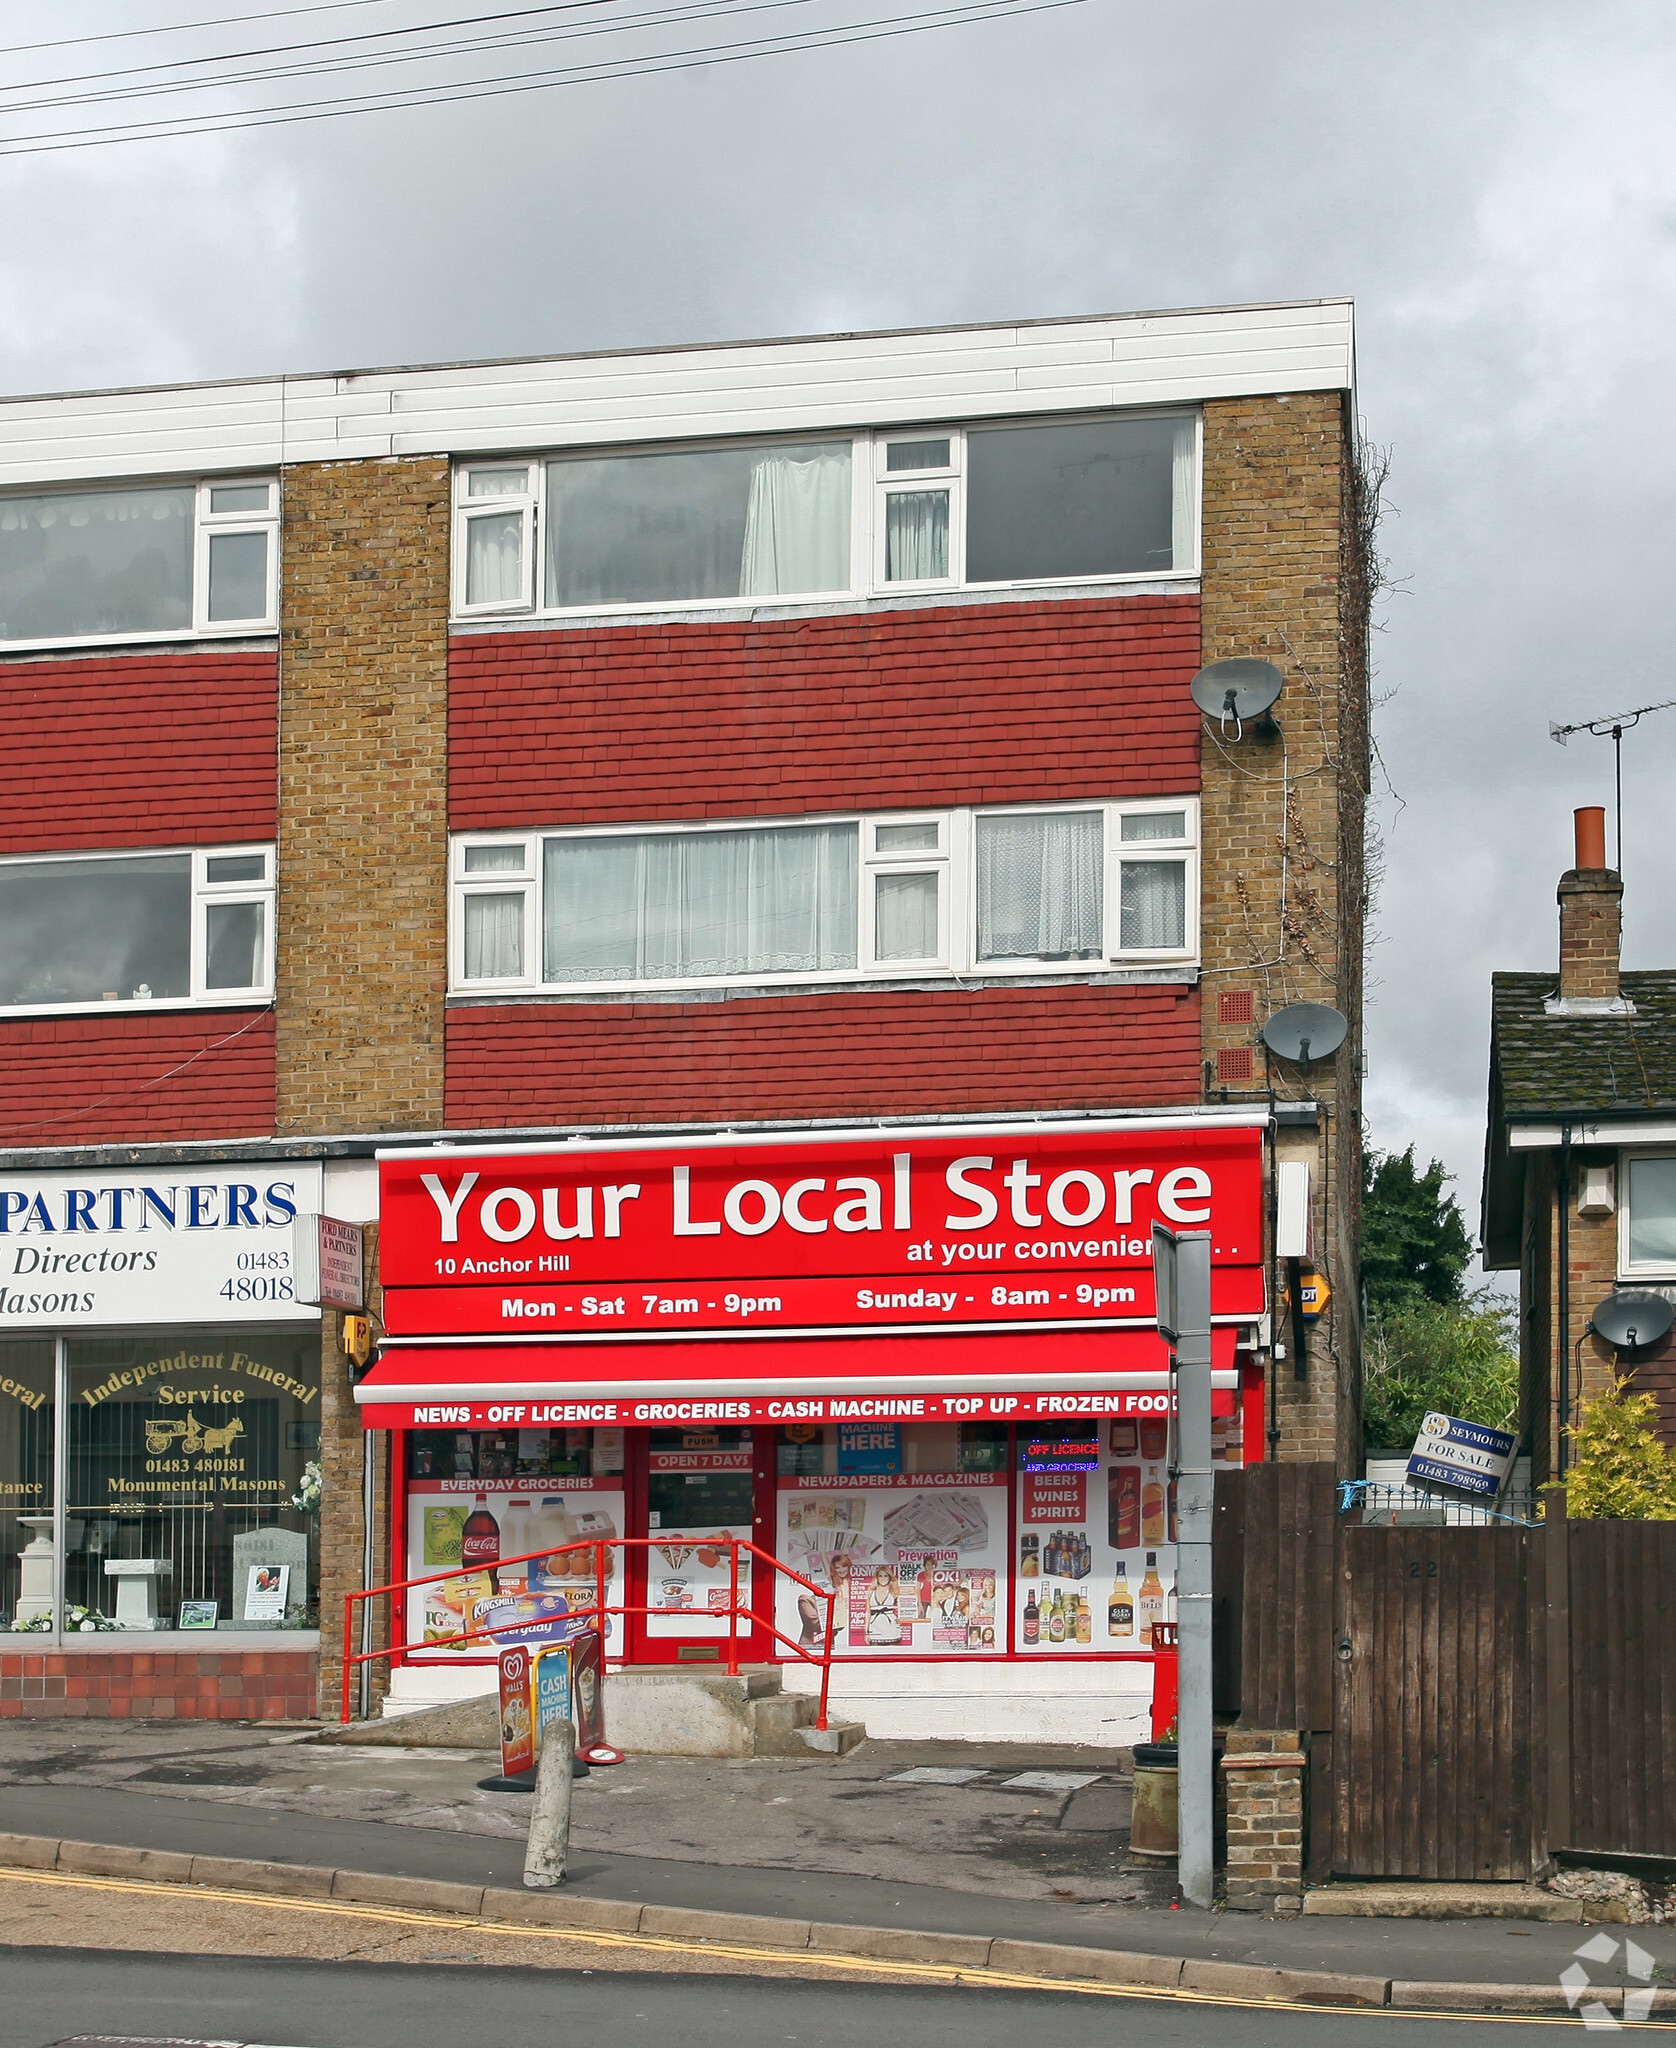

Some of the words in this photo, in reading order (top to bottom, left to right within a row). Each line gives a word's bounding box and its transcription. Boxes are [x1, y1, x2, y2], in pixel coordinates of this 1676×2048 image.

[420, 1171, 641, 1243] Your
[672, 1152, 911, 1237] Local
[945, 1155, 1212, 1231] Store
[0, 1182, 296, 1236] PARTNERS
[321, 1221, 337, 1236] FORD
[329, 1238, 357, 1256] PARTNERS
[906, 1240, 934, 1262] at
[941, 1242, 1005, 1266] your
[12, 1246, 158, 1275] Directors
[237, 1251, 290, 1271] 01483
[434, 1258, 456, 1275] 10
[461, 1256, 533, 1274] Anchor
[538, 1255, 570, 1272] Hill
[219, 1276, 294, 1301] 48018
[1301, 1289, 1317, 1300] DT
[501, 1298, 556, 1317] Mon
[581, 1296, 625, 1316] Sat
[642, 1295, 698, 1314] 7am
[724, 1293, 782, 1317] 9pm
[856, 1287, 957, 1311] Sunday
[990, 1286, 1050, 1306] 8am
[1076, 1284, 1135, 1307] 9pm
[80, 1351, 224, 1408] Independent
[230, 1352, 319, 1405] Funeral
[158, 1384, 245, 1406] Service
[413, 1407, 471, 1423] NEWS
[487, 1406, 525, 1422] OFF
[531, 1404, 617, 1421] LICENCE
[634, 1403, 751, 1420] GROCERIES
[767, 1401, 824, 1418] CASH
[829, 1399, 925, 1417] MACHINE
[942, 1398, 984, 1415] TOP
[989, 1397, 1018, 1414] UP
[1036, 1396, 1119, 1413] FROZEN
[841, 1423, 895, 1433] MACHINE
[841, 1433, 896, 1451] HERE
[1450, 1426, 1511, 1450] SEYMOURS
[1028, 1444, 1050, 1455] OFF
[1052, 1443, 1100, 1455] LICENCE
[1426, 1442, 1455, 1458] FOR
[1458, 1450, 1495, 1469] SALE
[145, 1459, 190, 1473] 01483
[194, 1458, 245, 1472] 480181
[658, 1456, 698, 1467] OPEN
[701, 1457, 708, 1466] 7
[713, 1455, 749, 1466] DAYS
[1026, 1463, 1045, 1471] AND
[108, 1477, 215, 1493] Monumental
[220, 1477, 286, 1492] Masons
[440, 1479, 514, 1491] EVERYDAY
[518, 1478, 594, 1489] GROCERIES
[798, 1475, 893, 1487] NEWSPAPERS
[897, 1475, 907, 1485] &
[911, 1473, 994, 1485] MAGAZINES
[1034, 1474, 1077, 1486] BEERS
[1416, 1463, 1448, 1479] 01483
[1452, 1472, 1489, 1490] 798969
[1033, 1490, 1078, 1502] WINES
[1031, 1505, 1080, 1518] SPIRITS
[898, 1550, 958, 1561] Prevention
[900, 1569, 917, 1577] OFF
[933, 1571, 960, 1583] OK!
[1410, 1561, 1437, 1578] 22
[564, 1588, 594, 1601] FLORA
[471, 1597, 516, 1622] KINGSMILL
[425, 1611, 444, 1627] PG
[540, 1675, 567, 1695] CASH
[541, 1693, 568, 1706] MACHINE
[542, 1704, 569, 1727] HERE
